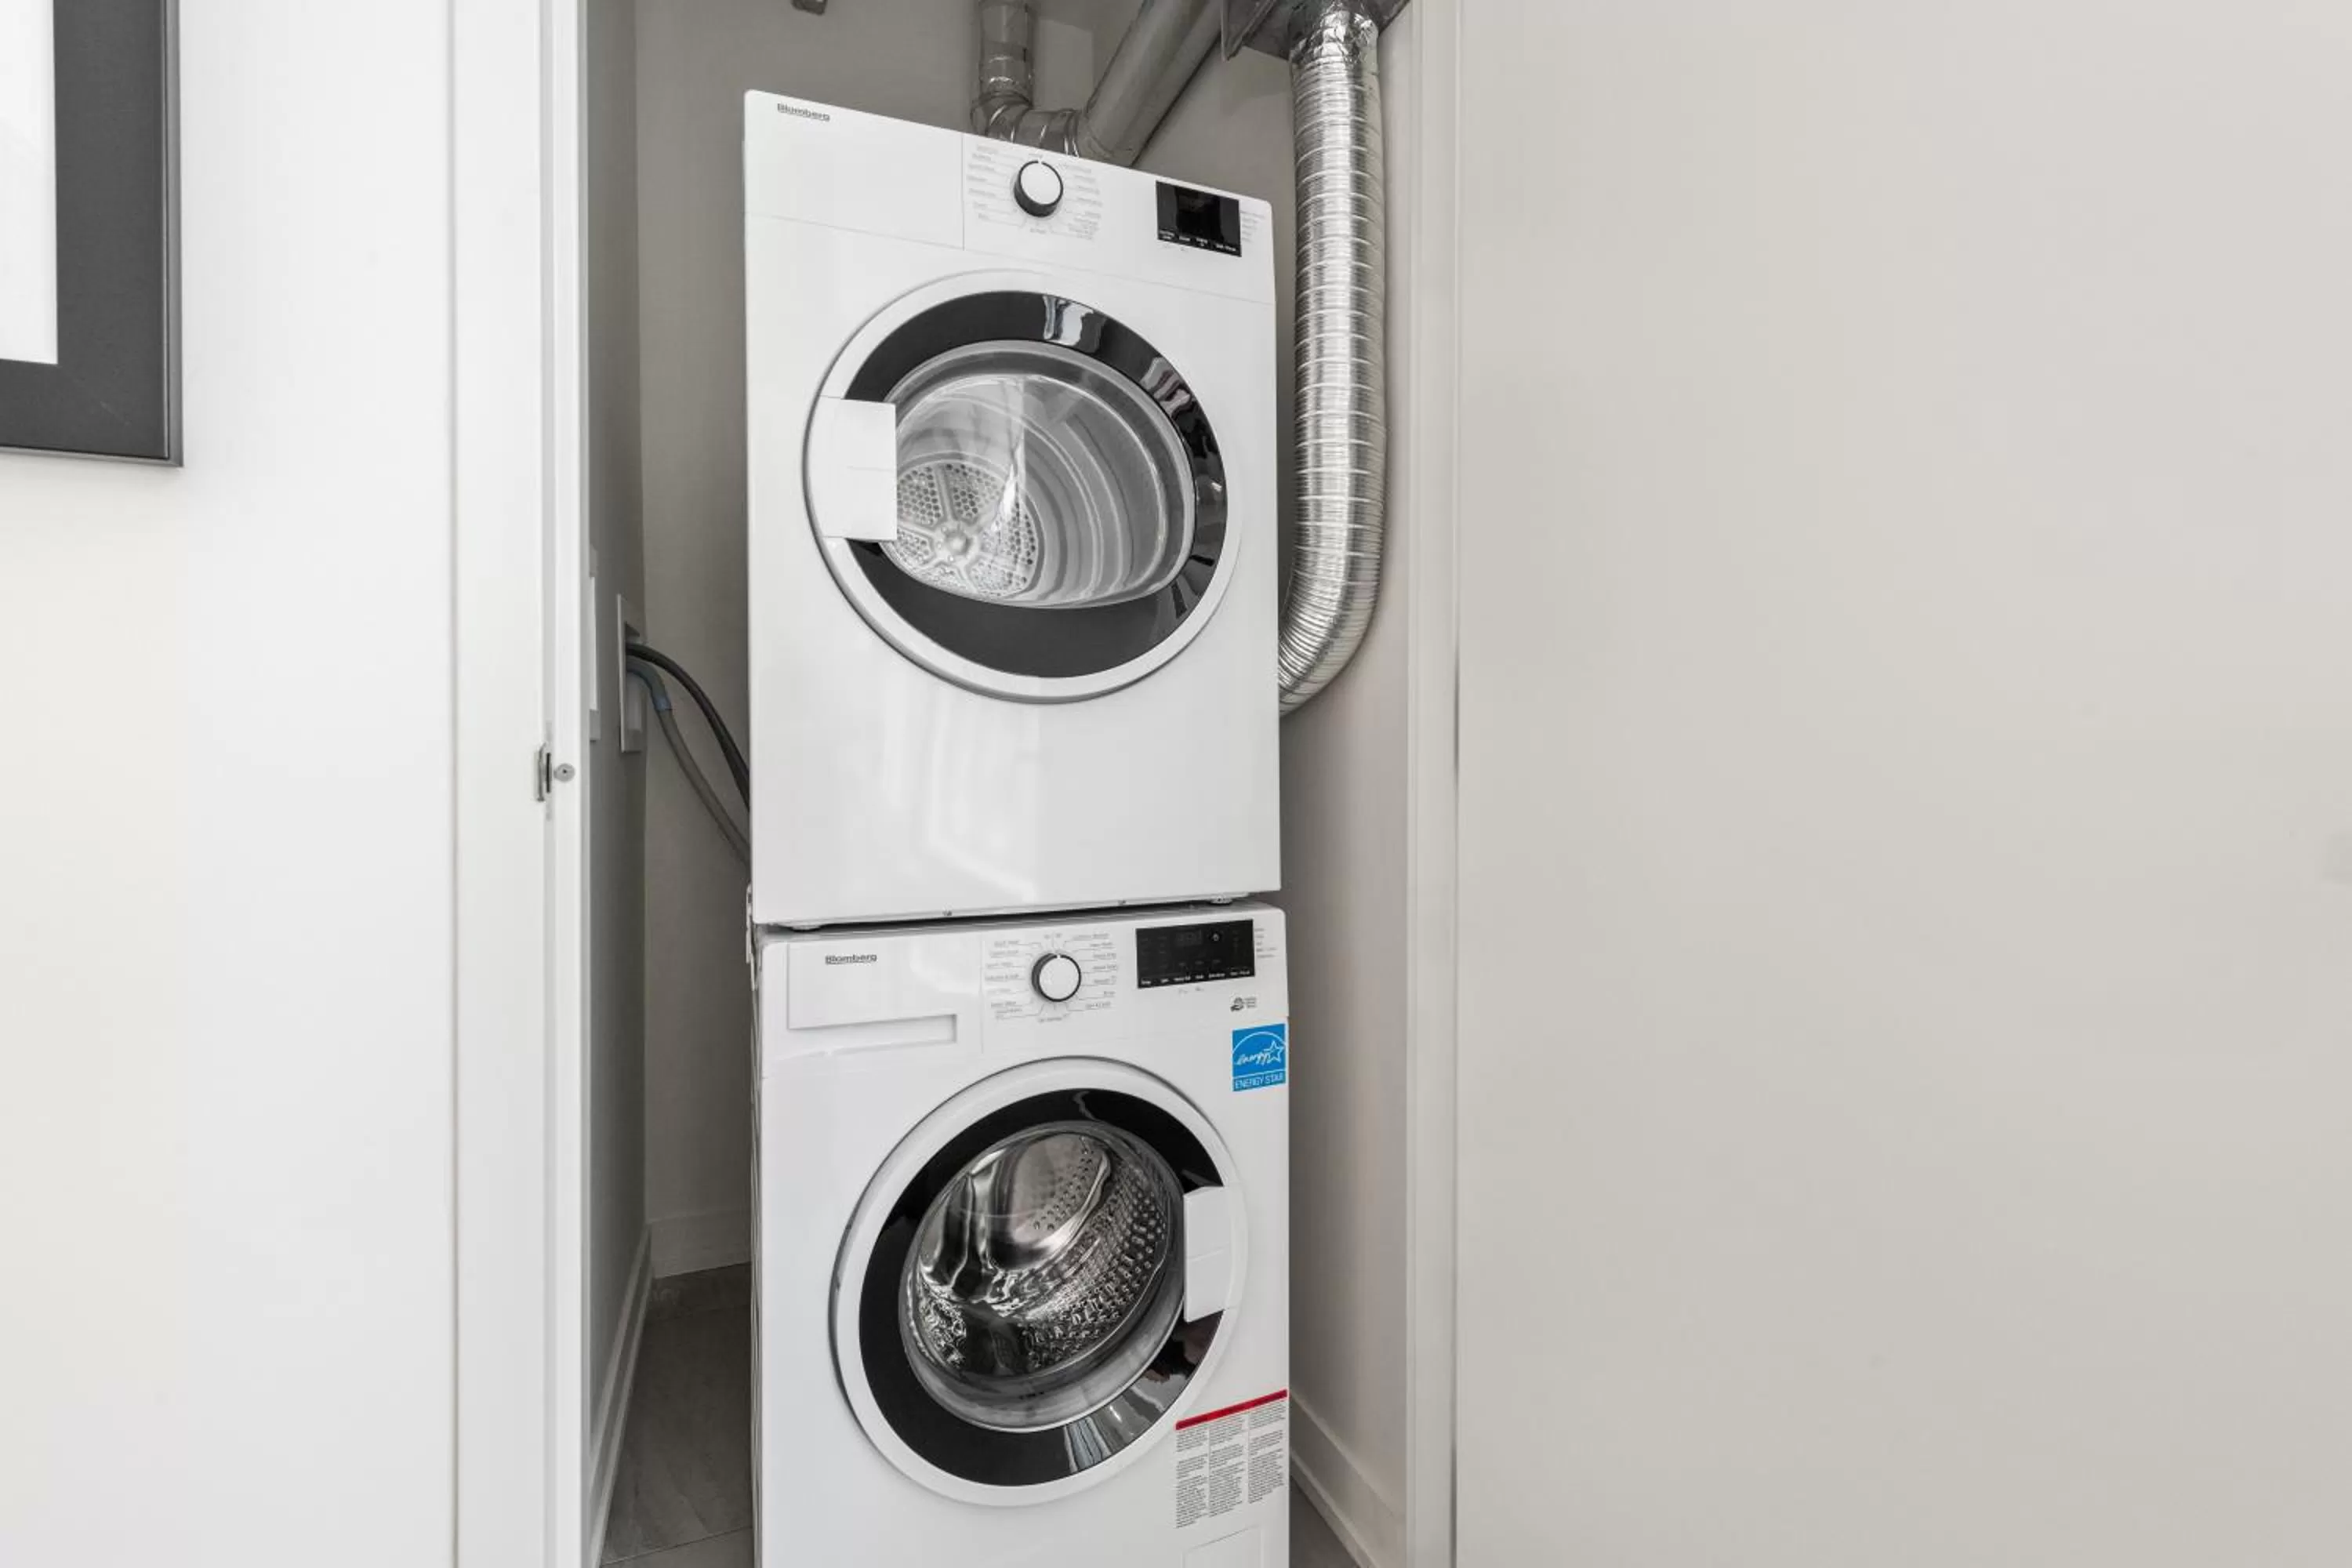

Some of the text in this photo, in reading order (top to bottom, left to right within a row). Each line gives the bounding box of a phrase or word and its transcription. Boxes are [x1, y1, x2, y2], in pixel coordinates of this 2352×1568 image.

[777, 103, 830, 122] Blomberg
[826, 954, 877, 964] Blomberg
[1236, 1072, 1283, 1089] ENERGY STAR
